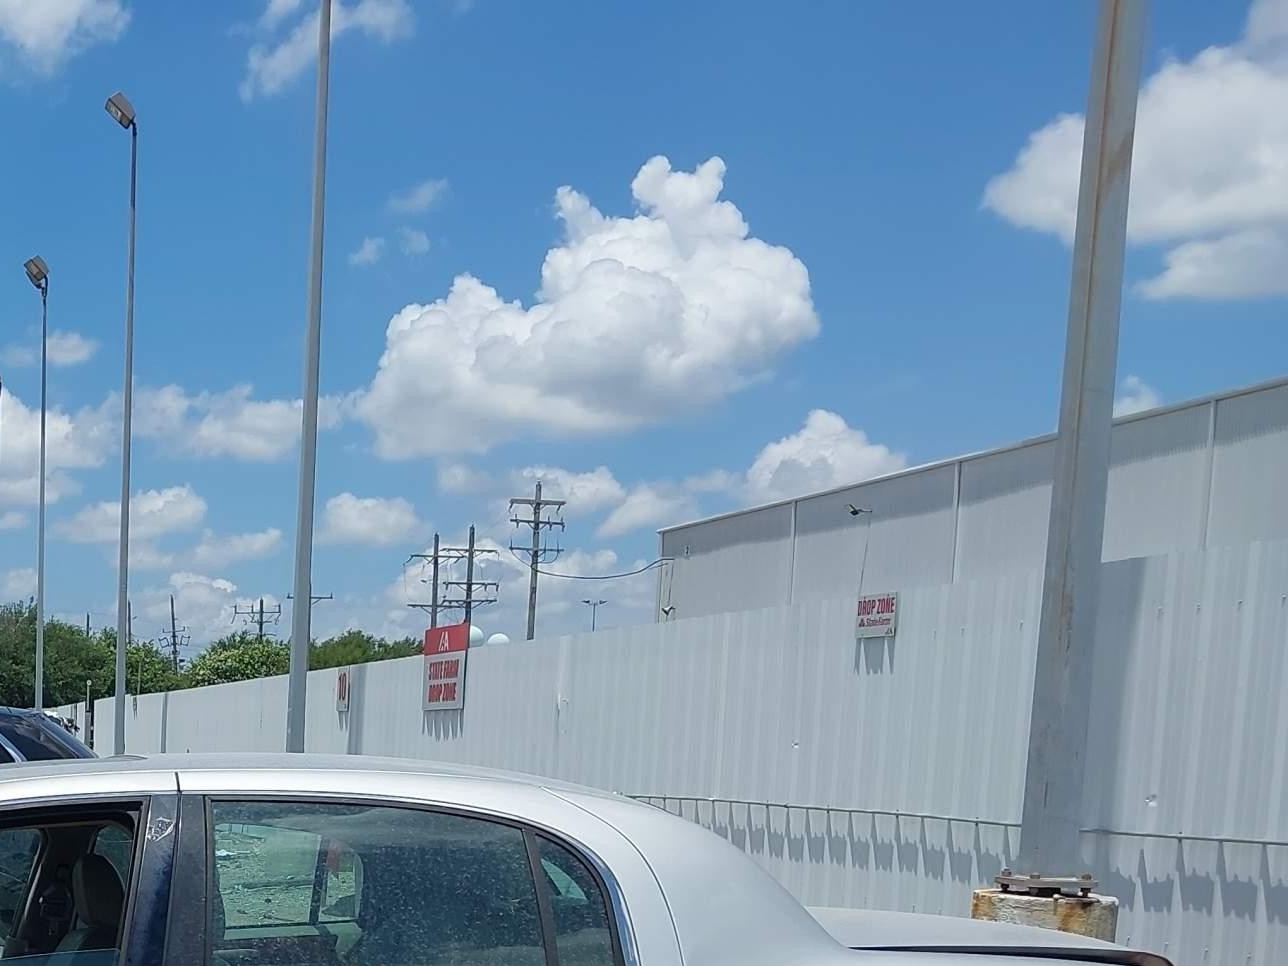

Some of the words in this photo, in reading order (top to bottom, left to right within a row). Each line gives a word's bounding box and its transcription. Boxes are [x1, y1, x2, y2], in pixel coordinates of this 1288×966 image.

[857, 599, 876, 617] DROP
[876, 597, 895, 615] ZONE
[338, 672, 347, 701] 10
